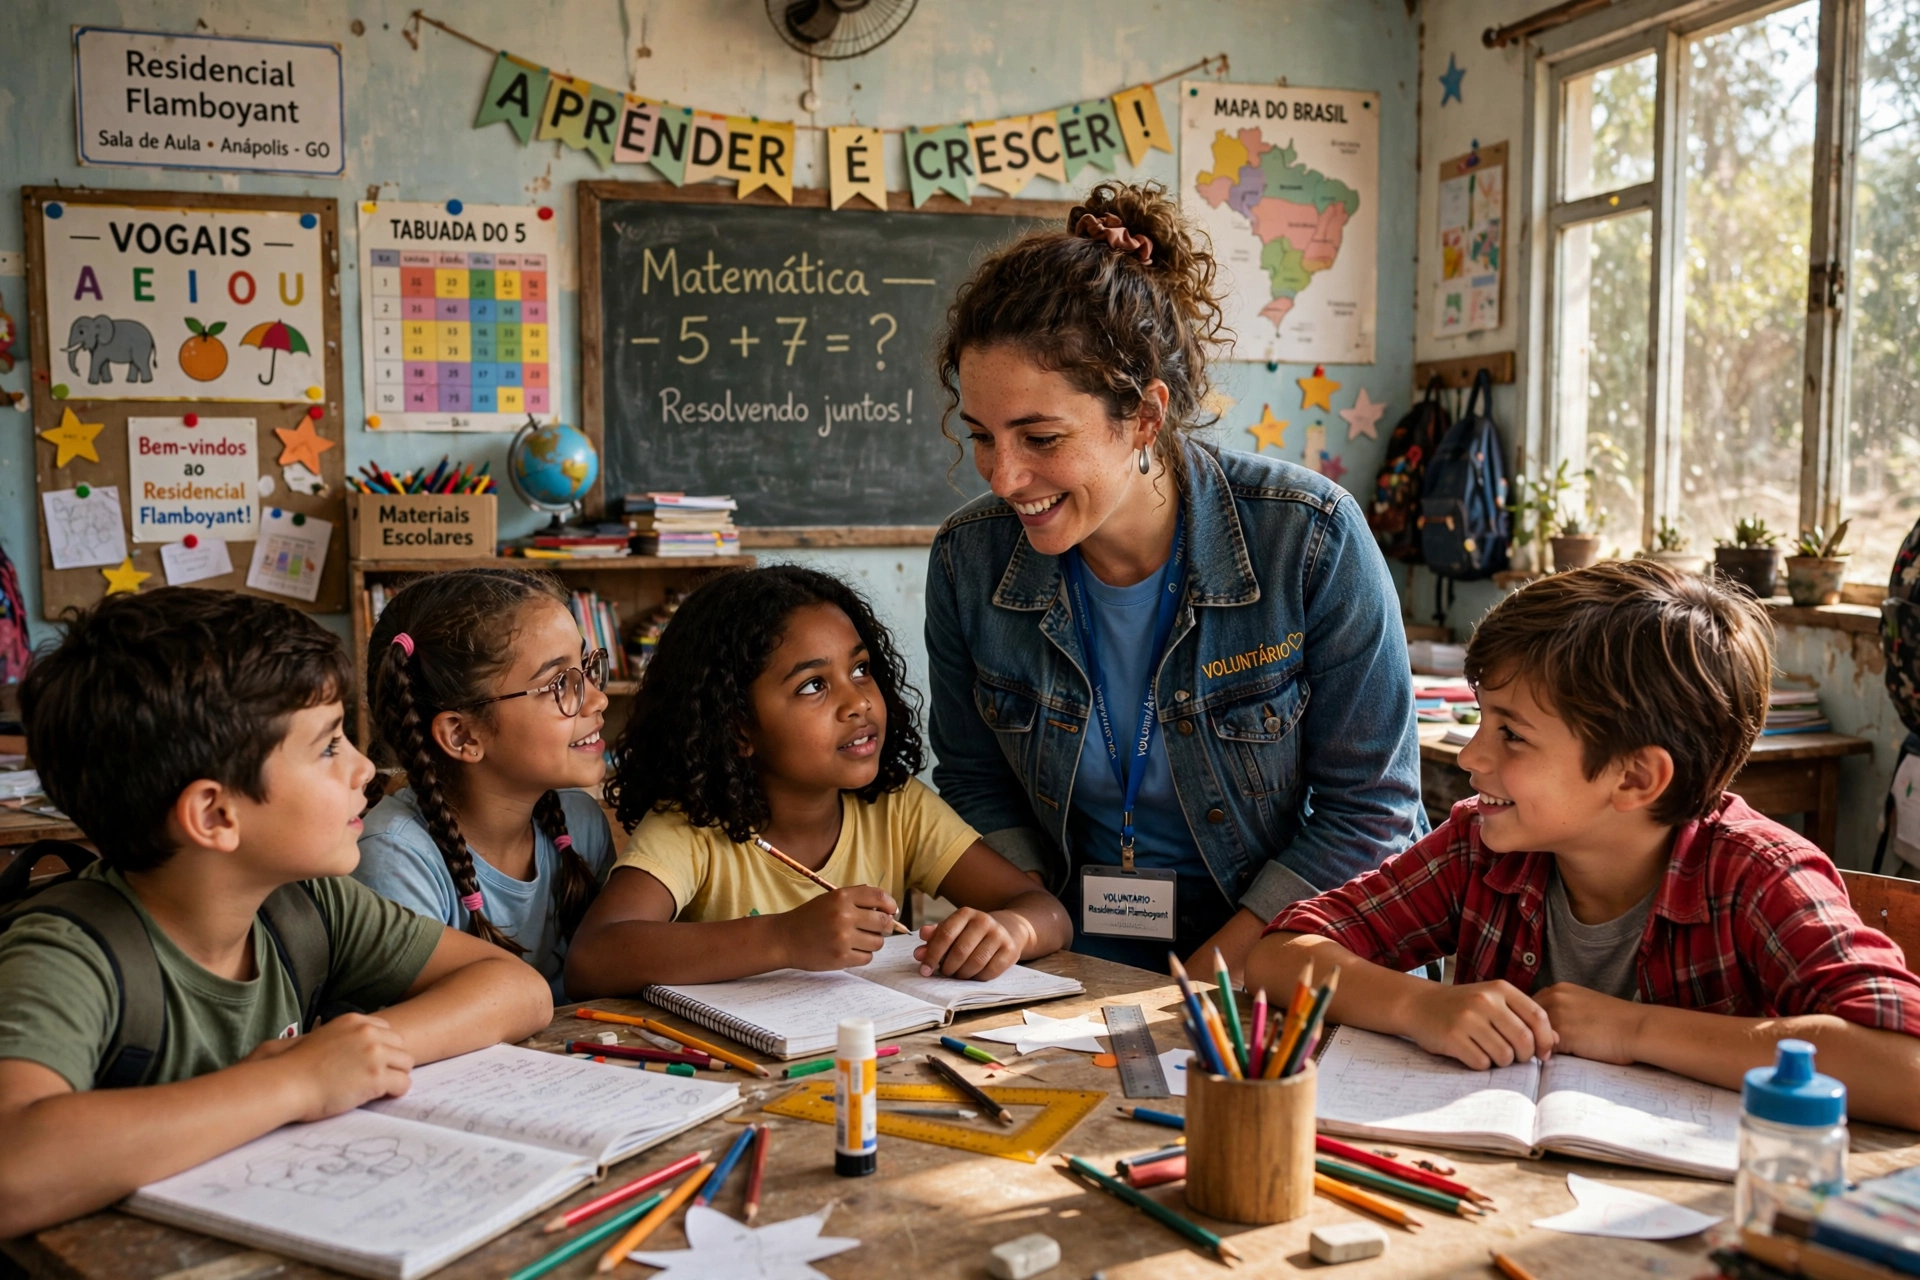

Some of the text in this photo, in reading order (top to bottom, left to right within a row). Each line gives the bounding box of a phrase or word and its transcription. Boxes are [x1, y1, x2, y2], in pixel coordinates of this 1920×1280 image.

[126, 50, 295, 87] Residencial
[126, 87, 299, 127] Flamboyant
[1214, 97, 1348, 124] MAPA DO BRASIL
[98, 130, 134, 148] Sala
[139, 132, 159, 149] de
[164, 134, 201, 151] Aula
[220, 137, 289, 159] Anápolis
[305, 142, 331, 158] GO
[845, 134, 870, 183] É
[109, 221, 251, 257] VOGAIS
[390, 219, 526, 243] TABUADA DO 5
[74, 265, 304, 306] A E I O U
[642, 248, 870, 296] Matemática
[677, 316, 709, 364] 5
[730, 326, 760, 357] +
[776, 317, 807, 366] 7
[826, 335, 850, 352] =
[869, 313, 897, 371] ?
[659, 387, 913, 437] Resolvendo juntos!
[138, 436, 247, 456] Bem-vindos
[183, 463, 205, 476] ao
[143, 482, 246, 500] Residencial
[140, 505, 251, 529] Flamboyant!
[379, 505, 470, 523] Materiais
[383, 527, 474, 546] Escolares
[1201, 643, 1290, 679] VOLUNTÁRIO
